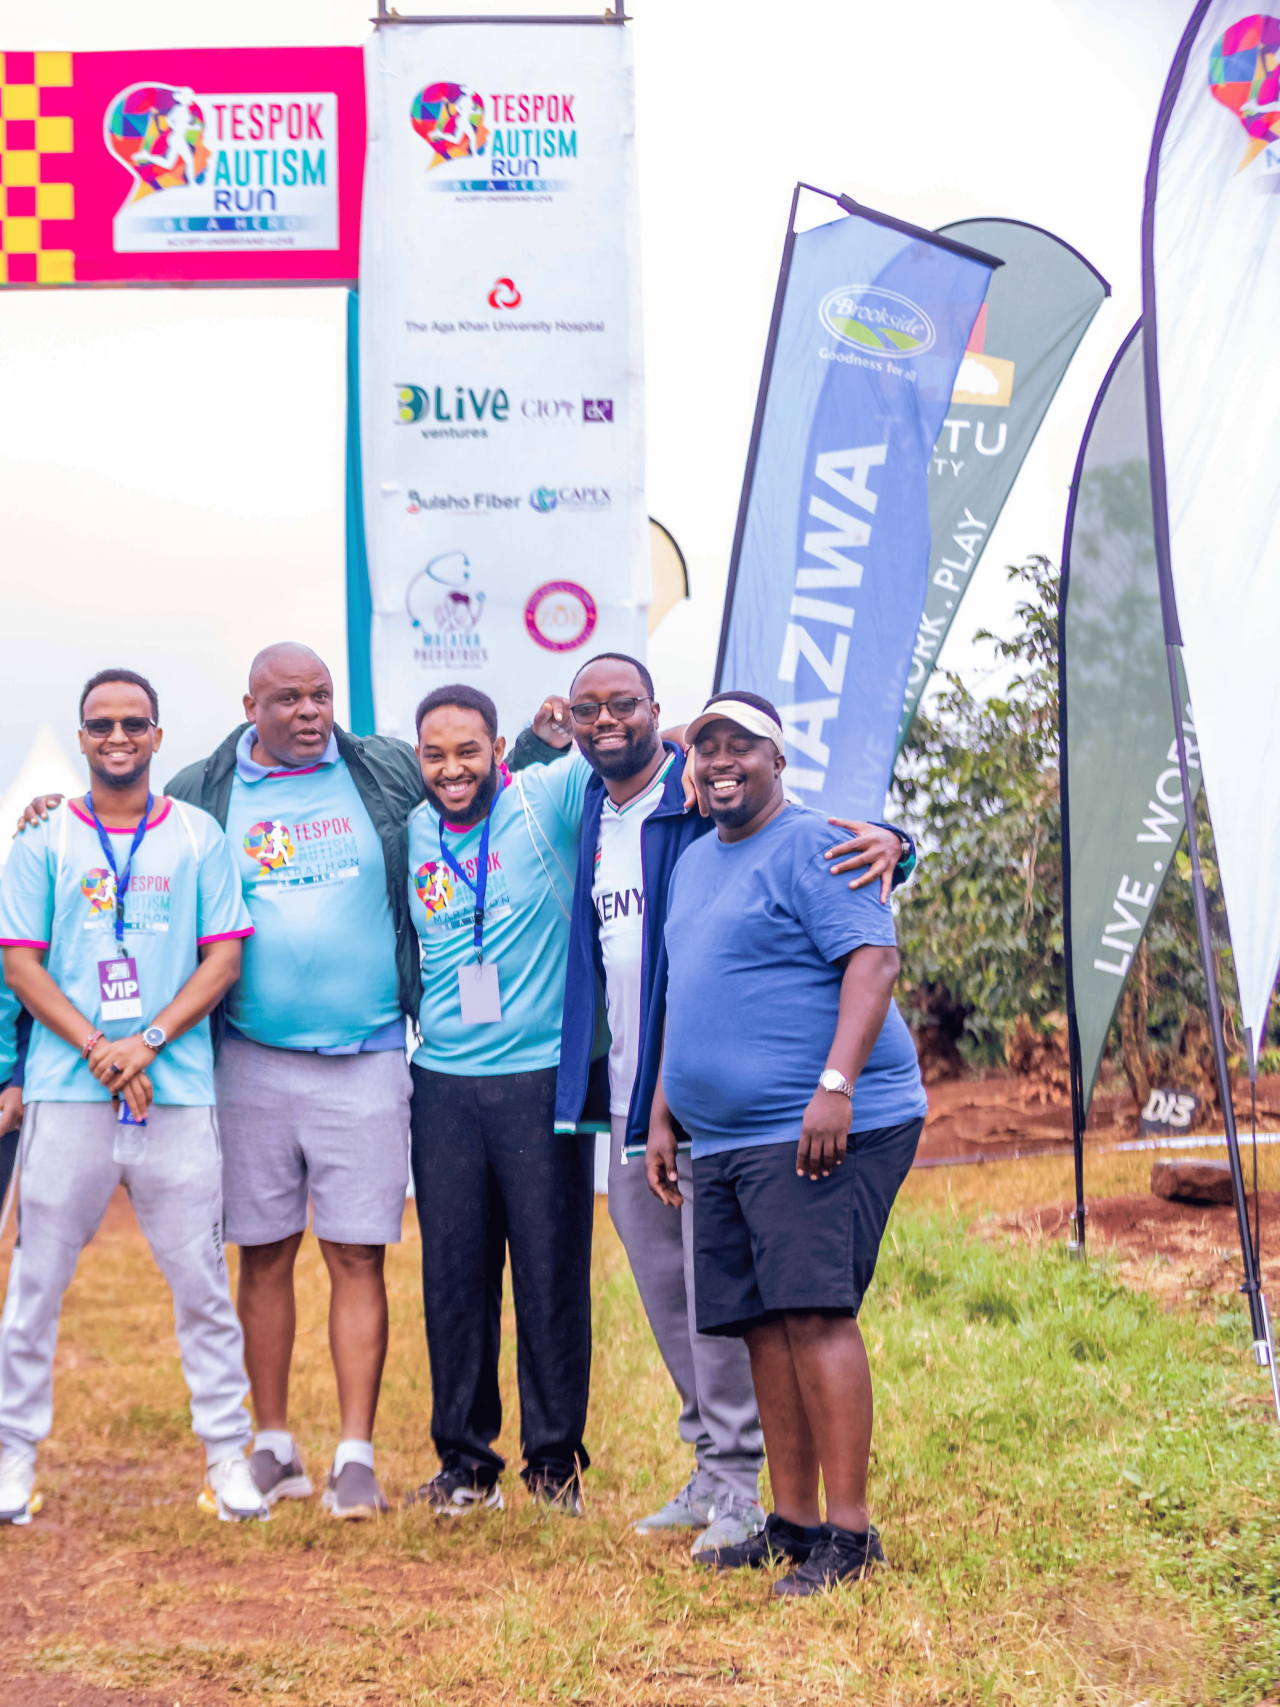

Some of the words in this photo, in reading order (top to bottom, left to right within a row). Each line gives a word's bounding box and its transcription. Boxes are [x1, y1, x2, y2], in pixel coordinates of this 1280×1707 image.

[212, 103, 324, 141] TESPOK
[490, 94, 575, 124] TESPOK
[492, 129, 577, 158] AUTISM
[214, 149, 326, 186] AUTISM
[405, 320, 429, 333] The
[431, 320, 455, 335] Aga
[458, 320, 490, 333] Khan
[493, 320, 552, 335] University
[556, 320, 605, 335] Hospital
[835, 297, 926, 335] Brookside
[818, 347, 883, 372] Goodness
[886, 361, 903, 378] for
[421, 426, 489, 440] ventures
[474, 491, 521, 510] Fiber
[932, 506, 988, 592] PLAY
[293, 817, 353, 842] TESPOK
[298, 836, 359, 863] AUTISM
[270, 857, 360, 879] MARATHON
[298, 877, 306, 885] A
[313, 870, 345, 884] HERO
[1093, 874, 1156, 977] LIVE
[102, 980, 138, 1000] VIP
[212, 1222, 225, 1273] NIKE
